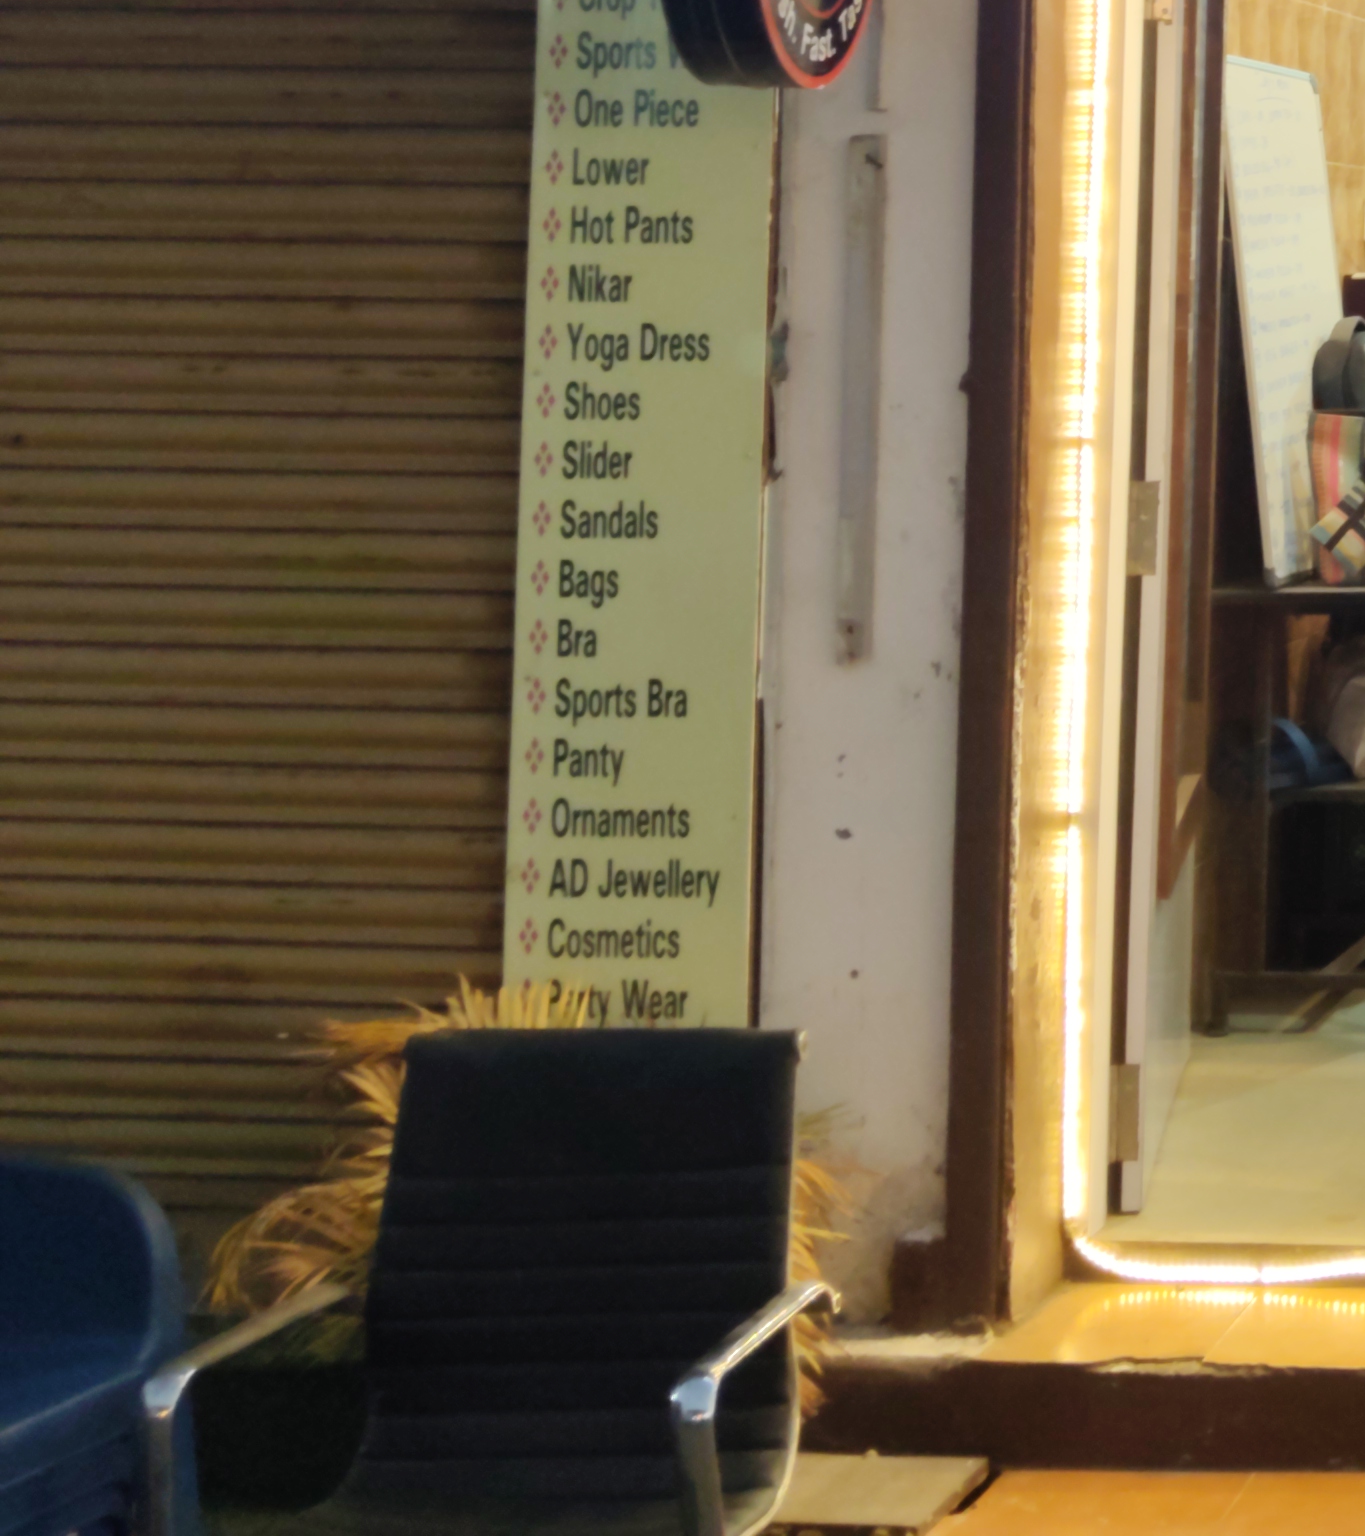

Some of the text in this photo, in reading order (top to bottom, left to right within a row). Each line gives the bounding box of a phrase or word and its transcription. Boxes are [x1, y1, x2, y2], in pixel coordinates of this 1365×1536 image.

[576, 30, 657, 79] Sports
[574, 88, 700, 128] One Piece
[571, 149, 650, 186] Lower
[569, 207, 695, 245] Hot Pants
[568, 264, 633, 303] Nikar
[567, 323, 710, 371] Yoga Dress
[564, 381, 641, 421] Shoes
[562, 440, 633, 480] Slider
[560, 500, 659, 540] Sandals
[558, 559, 619, 609] Bags
[557, 619, 598, 658] Bra
[554, 678, 688, 726] Sports Bra
[553, 738, 625, 787] Panty
[551, 797, 691, 838] Ornaments
[548, 858, 721, 908] AD Jewellery
[547, 918, 681, 960] Cosmetics
[621, 979, 688, 1019] Wear
